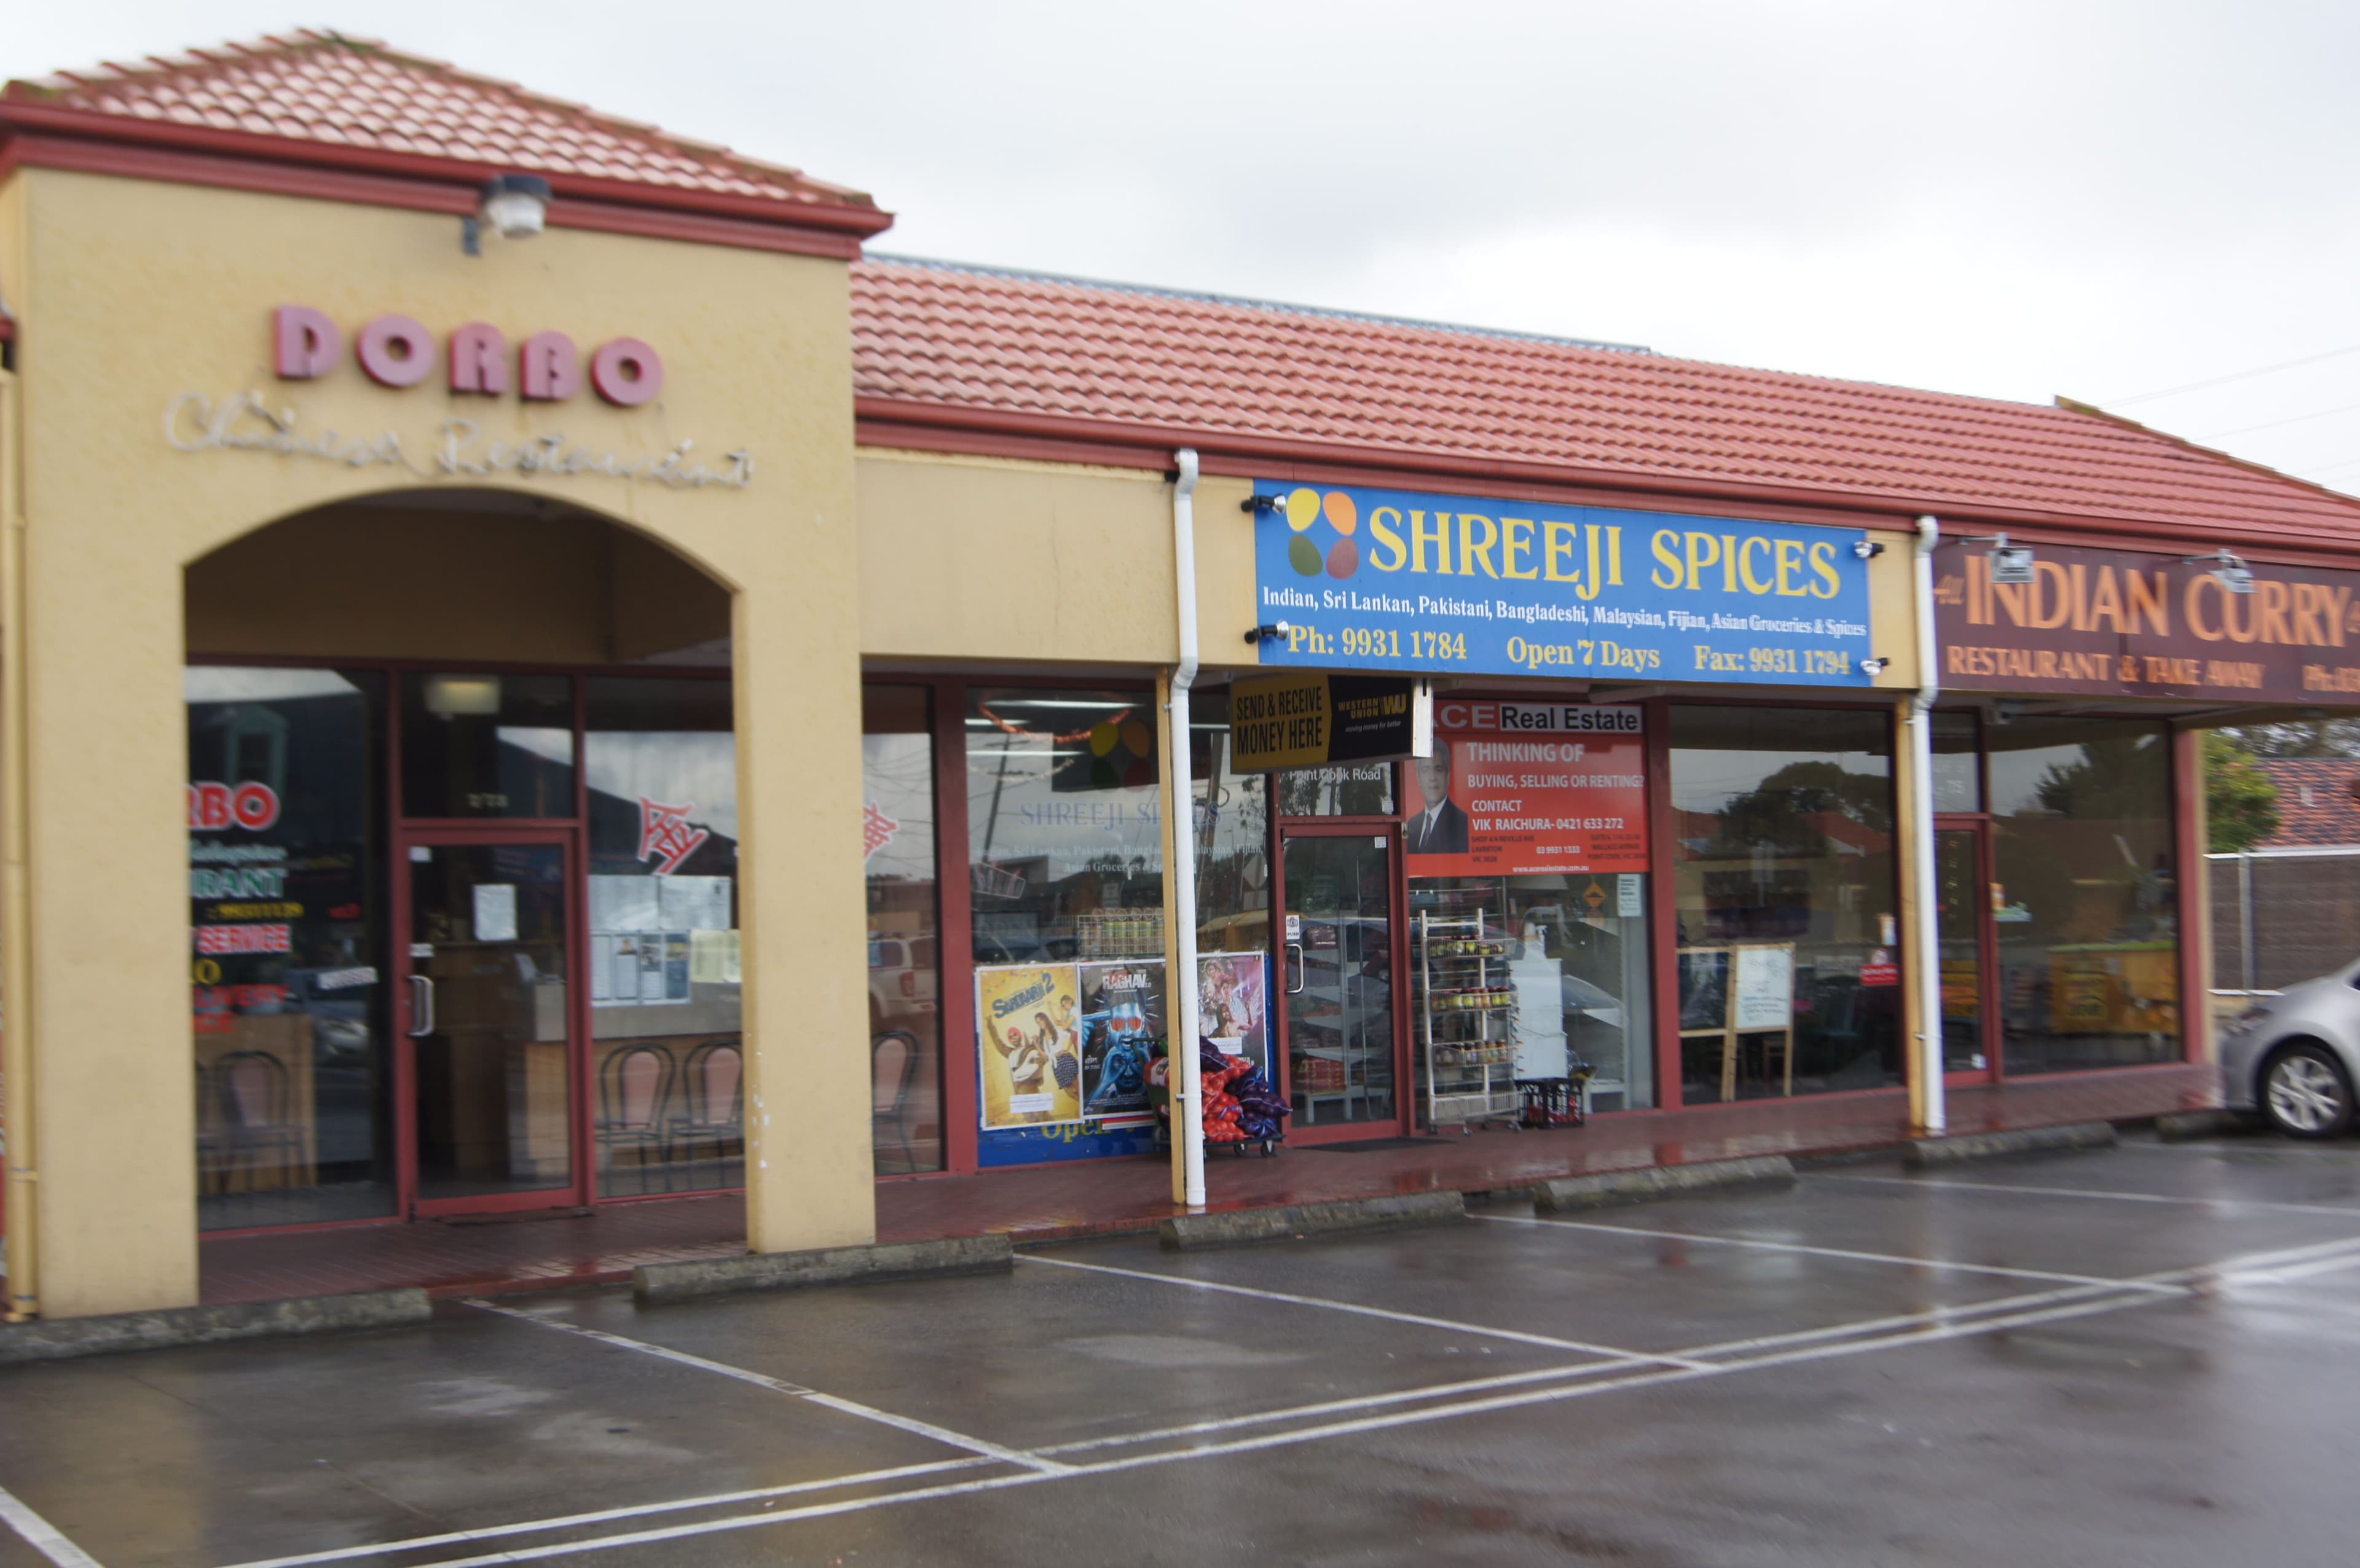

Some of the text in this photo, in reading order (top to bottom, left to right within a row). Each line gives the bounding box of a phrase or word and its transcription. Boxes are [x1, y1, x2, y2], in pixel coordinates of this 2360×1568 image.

[272, 304, 664, 407] DORBO
[1369, 506, 1841, 600] SHREEJI SPICES
[1263, 586, 1867, 639] Indian, Sri Lankan, Pakistani, Bangladeshi, Malaysian, Fijian, Asian Groceries & Spices
[1964, 555, 2171, 637] INDIAN
[2184, 574, 2353, 648] CURRY
[1288, 624, 1467, 659] Ph: 9931 1784
[1507, 637, 1661, 673] Open 7 Days
[1694, 645, 1851, 675] Fax: 9931 1794
[1947, 645, 2267, 689] RESTAURANT & TAKE AWAY
[1237, 686, 1322, 721] SEND & RECEIVE
[1338, 697, 1379, 711] WESTERN
[1350, 707, 1379, 719] UNION
[1433, 704, 1638, 730] CE Real Estate
[1237, 717, 1323, 756] MONEY HERE
[1466, 742, 1584, 762] THINKING OF
[1353, 768, 1380, 781] Road
[1468, 774, 1645, 790] BUYING, SELLING OR RENTING?
[1020, 802, 1125, 830] SHREEJI
[1472, 799, 1522, 812] CONTACT
[1472, 818, 1492, 831] VIK
[1556, 818, 1581, 830] 0421
[1584, 818, 1603, 830] 633
[1605, 817, 1624, 829] 272
[1093, 861, 1141, 872] Groceries
